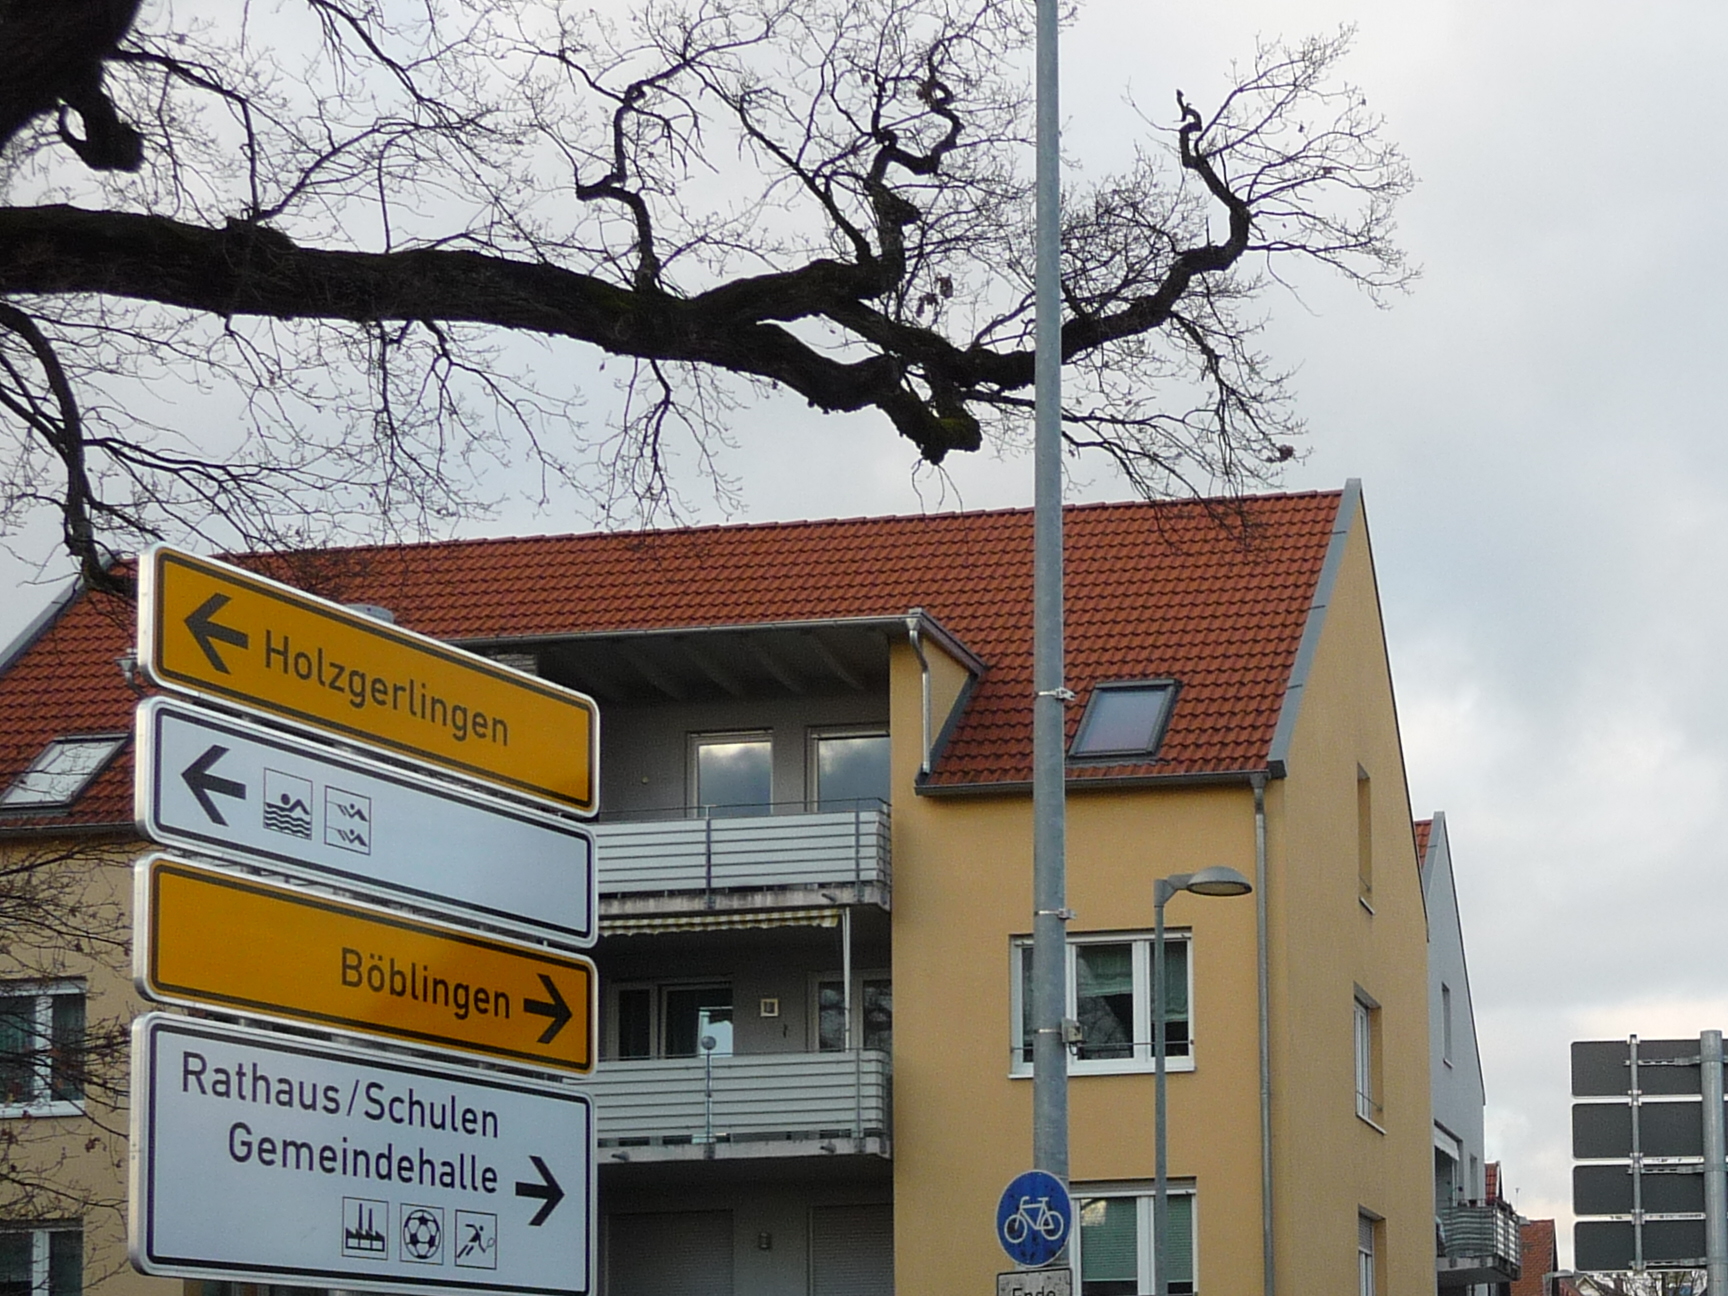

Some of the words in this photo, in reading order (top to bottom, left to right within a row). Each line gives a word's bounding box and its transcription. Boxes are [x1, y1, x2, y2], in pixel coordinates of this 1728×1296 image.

[264, 629, 509, 746] Holzgerlingen
[341, 946, 511, 1020] Böblingen
[228, 1122, 498, 1194] Gemeindehalle
